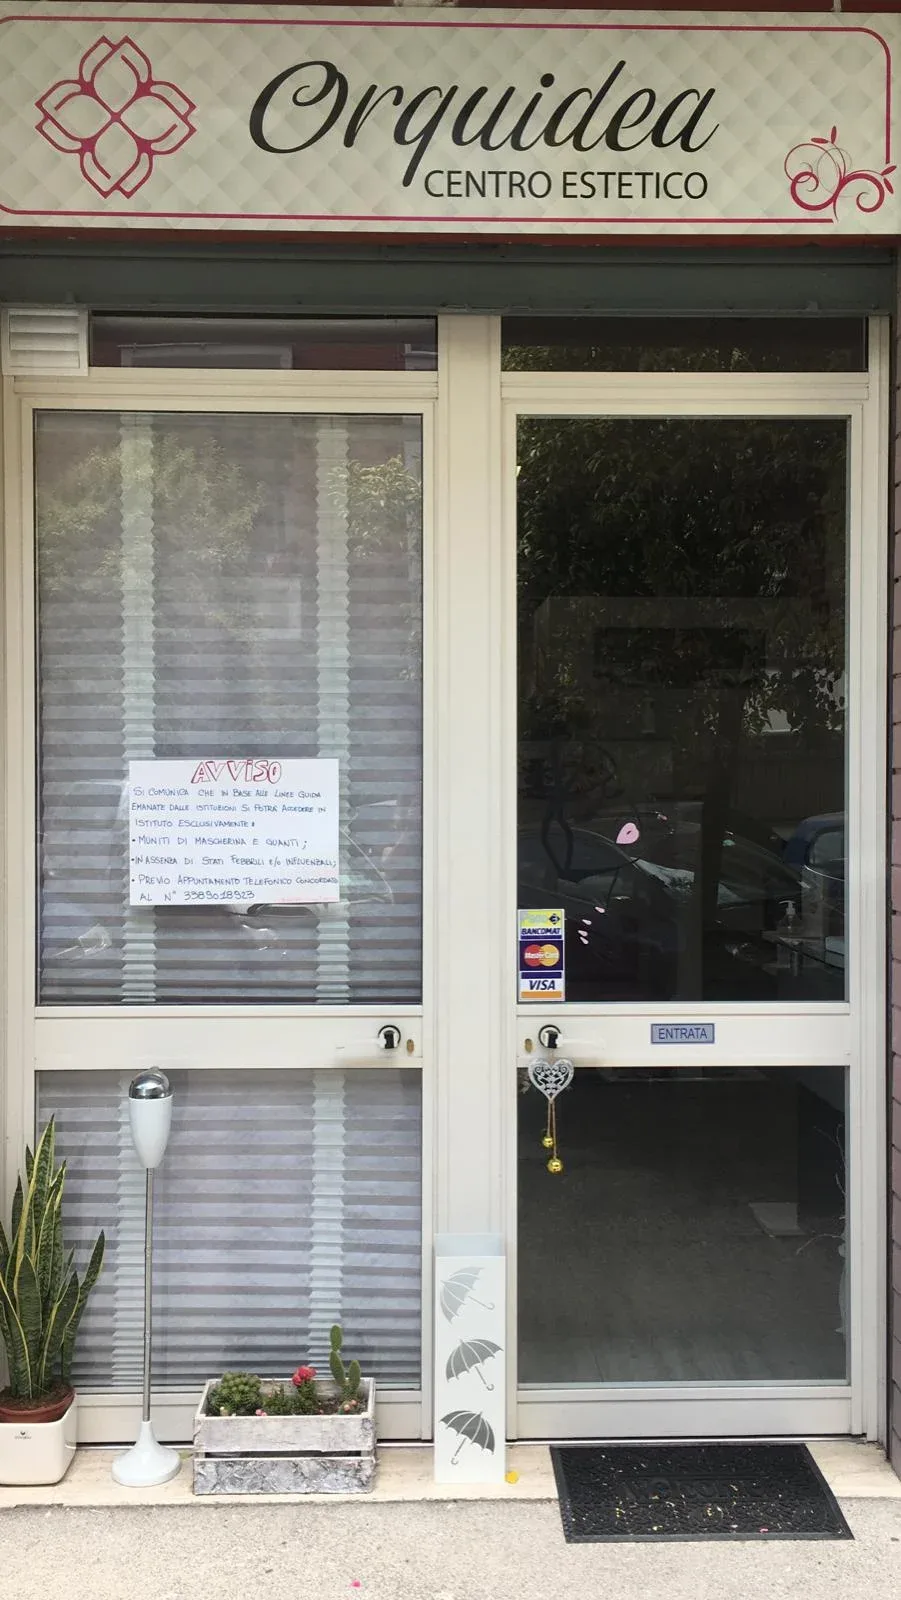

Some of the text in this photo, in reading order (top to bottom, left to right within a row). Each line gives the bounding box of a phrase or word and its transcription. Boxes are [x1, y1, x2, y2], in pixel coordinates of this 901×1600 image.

[249, 60, 720, 187] Orquidea
[424, 169, 709, 200] CENTRO ESTETICO
[198, 788, 214, 797] CHE
[232, 788, 251, 797] BASE
[298, 790, 321, 799] GUIDA
[131, 802, 165, 811] EMANATE
[281, 804, 314, 813] ACCEDERE
[135, 819, 173, 827] ISTITUTO
[178, 819, 249, 828] ESCLUSIVAMENTE
[138, 835, 170, 845] MUNITI
[177, 837, 188, 845] DI
[194, 837, 247, 846] MASCHERINA
[252, 838, 259, 846] E
[145, 856, 178, 865] ASSENZA
[230, 854, 265, 866] FEBBRILI
[138, 874, 171, 885] PREVIO
[177, 875, 240, 886] APPUNTAMENTO
[245, 877, 293, 886] TELEFONICO
[139, 893, 153, 902] AL
[520, 927, 561, 935] BANCOMAT
[528, 979, 556, 991] VISA
[658, 1027, 708, 1040] ENTRATA
